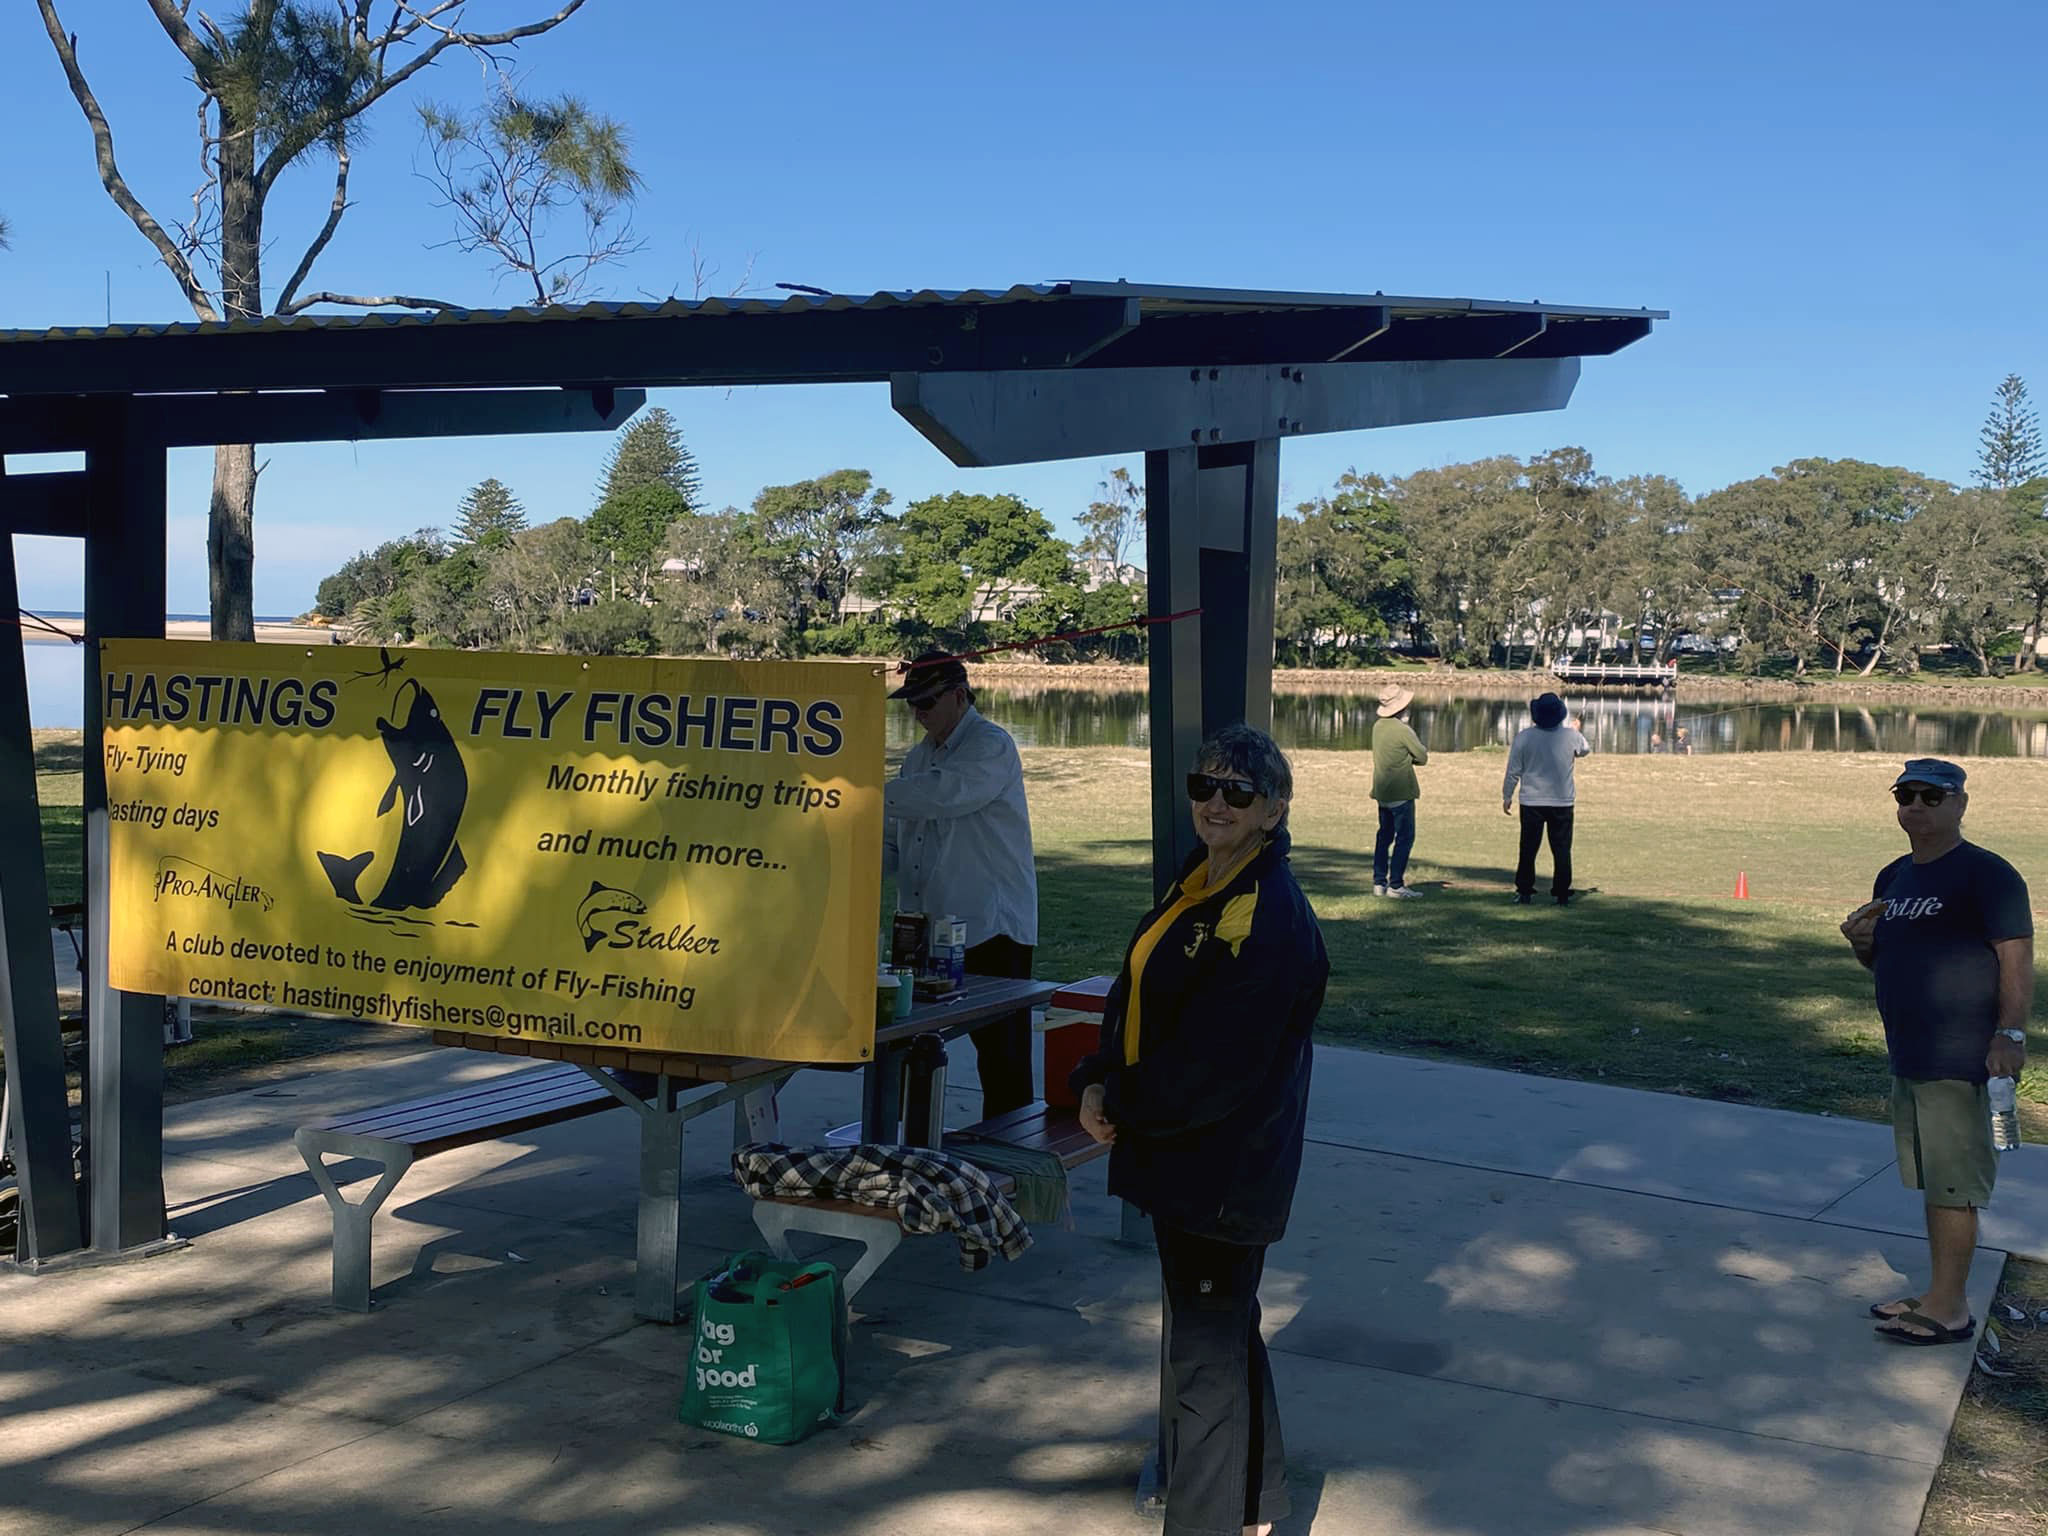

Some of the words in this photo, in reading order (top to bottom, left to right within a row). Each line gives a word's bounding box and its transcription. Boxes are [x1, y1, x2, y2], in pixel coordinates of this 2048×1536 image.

[105, 672, 339, 728] HASTINGS
[469, 687, 575, 740] FLY
[583, 691, 843, 757] FISHERS
[106, 744, 187, 776] Fly-Tying
[546, 764, 658, 800] Monthly
[665, 770, 764, 809] fishing
[773, 779, 841, 812] trips
[108, 798, 167, 829] asting
[173, 802, 220, 832] days
[537, 829, 593, 855] and
[598, 833, 677, 861] much
[686, 843, 787, 871] more...
[608, 920, 721, 955] Stalker
[166, 930, 177, 951] A
[182, 932, 224, 957] club
[231, 937, 319, 966] devoted
[326, 946, 345, 968] to
[352, 949, 386, 974] the
[394, 957, 515, 987] enjoyment
[522, 965, 549, 990] of
[553, 969, 696, 1010] Fly-Fishing
[188, 976, 276, 1003] contact:
[283, 981, 642, 1043] hastingsflyfishers@gmail.com
[698, 1336, 722, 1364] or
